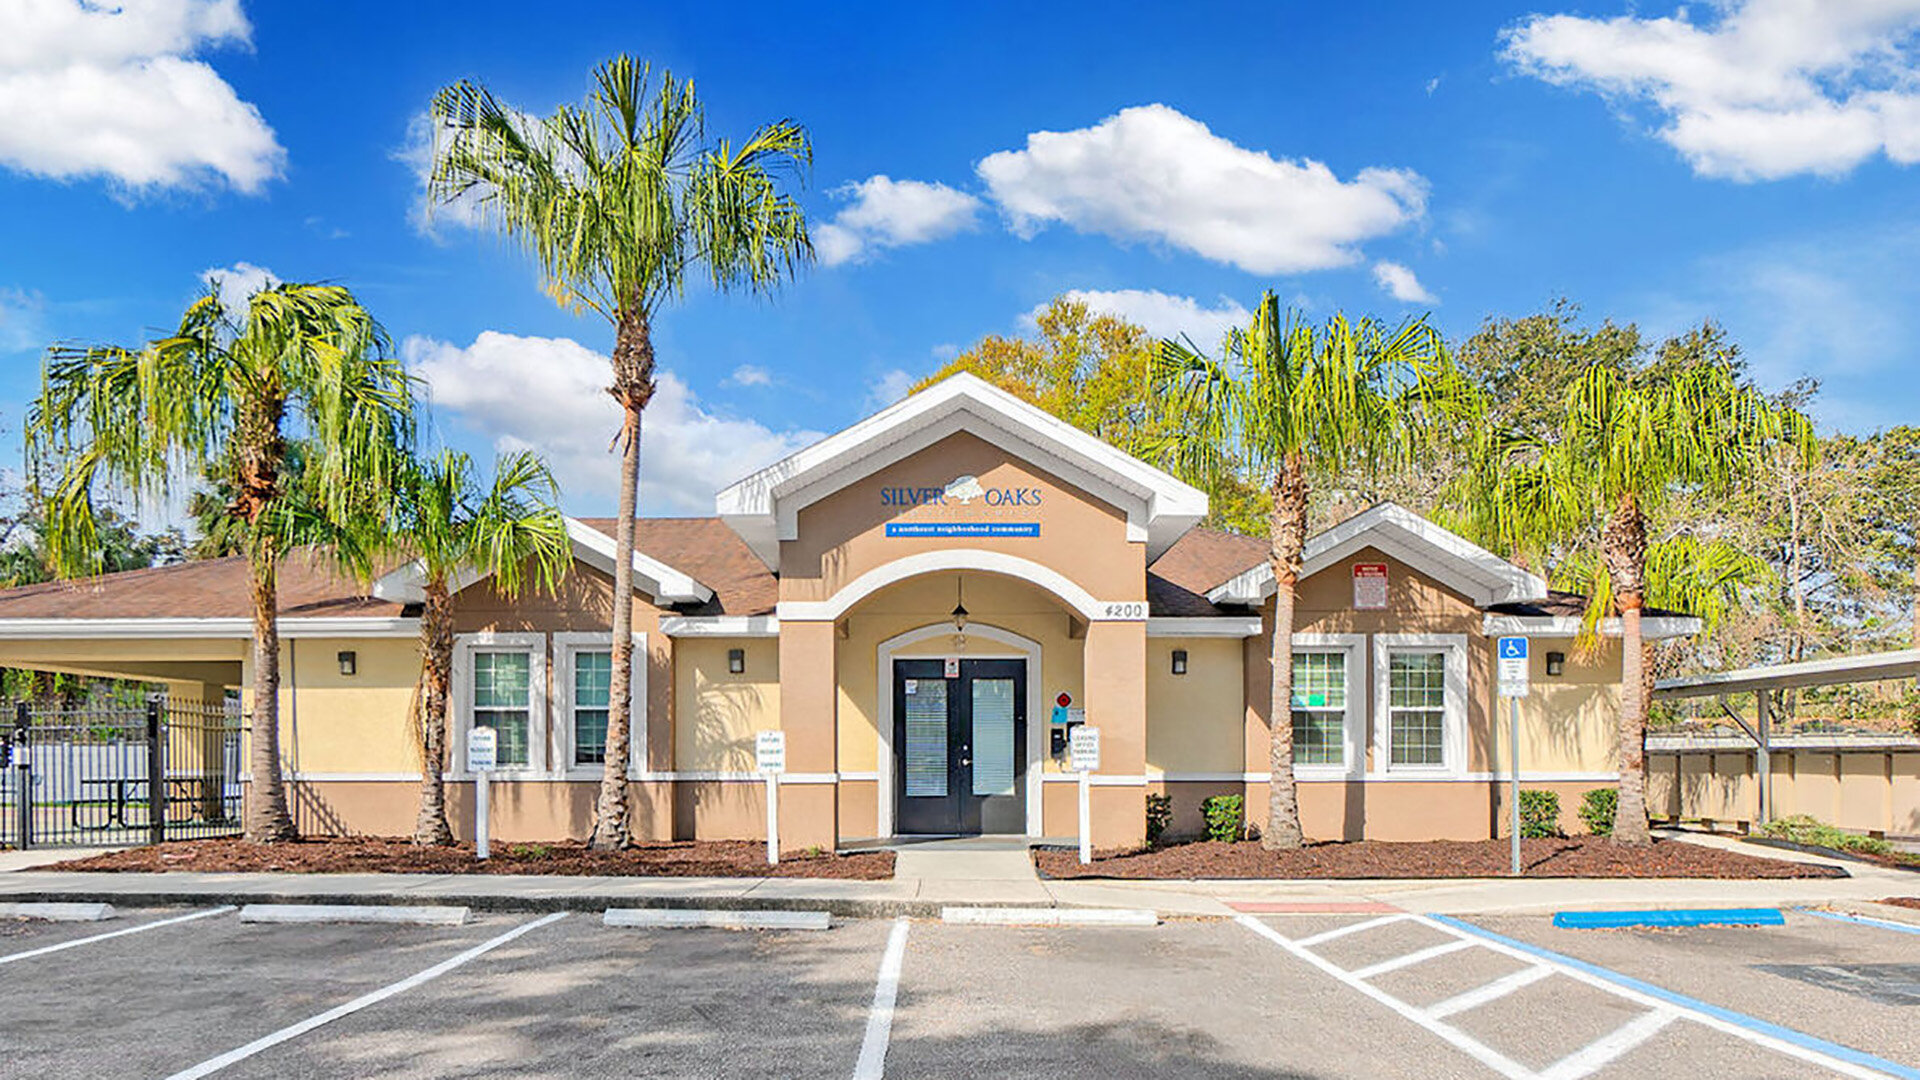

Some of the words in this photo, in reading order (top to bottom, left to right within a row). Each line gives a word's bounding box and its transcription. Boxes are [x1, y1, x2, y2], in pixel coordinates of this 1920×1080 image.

[880, 487, 947, 506] SILVER
[984, 487, 1043, 506] OAKS
[1105, 603, 1142, 618] 4200
